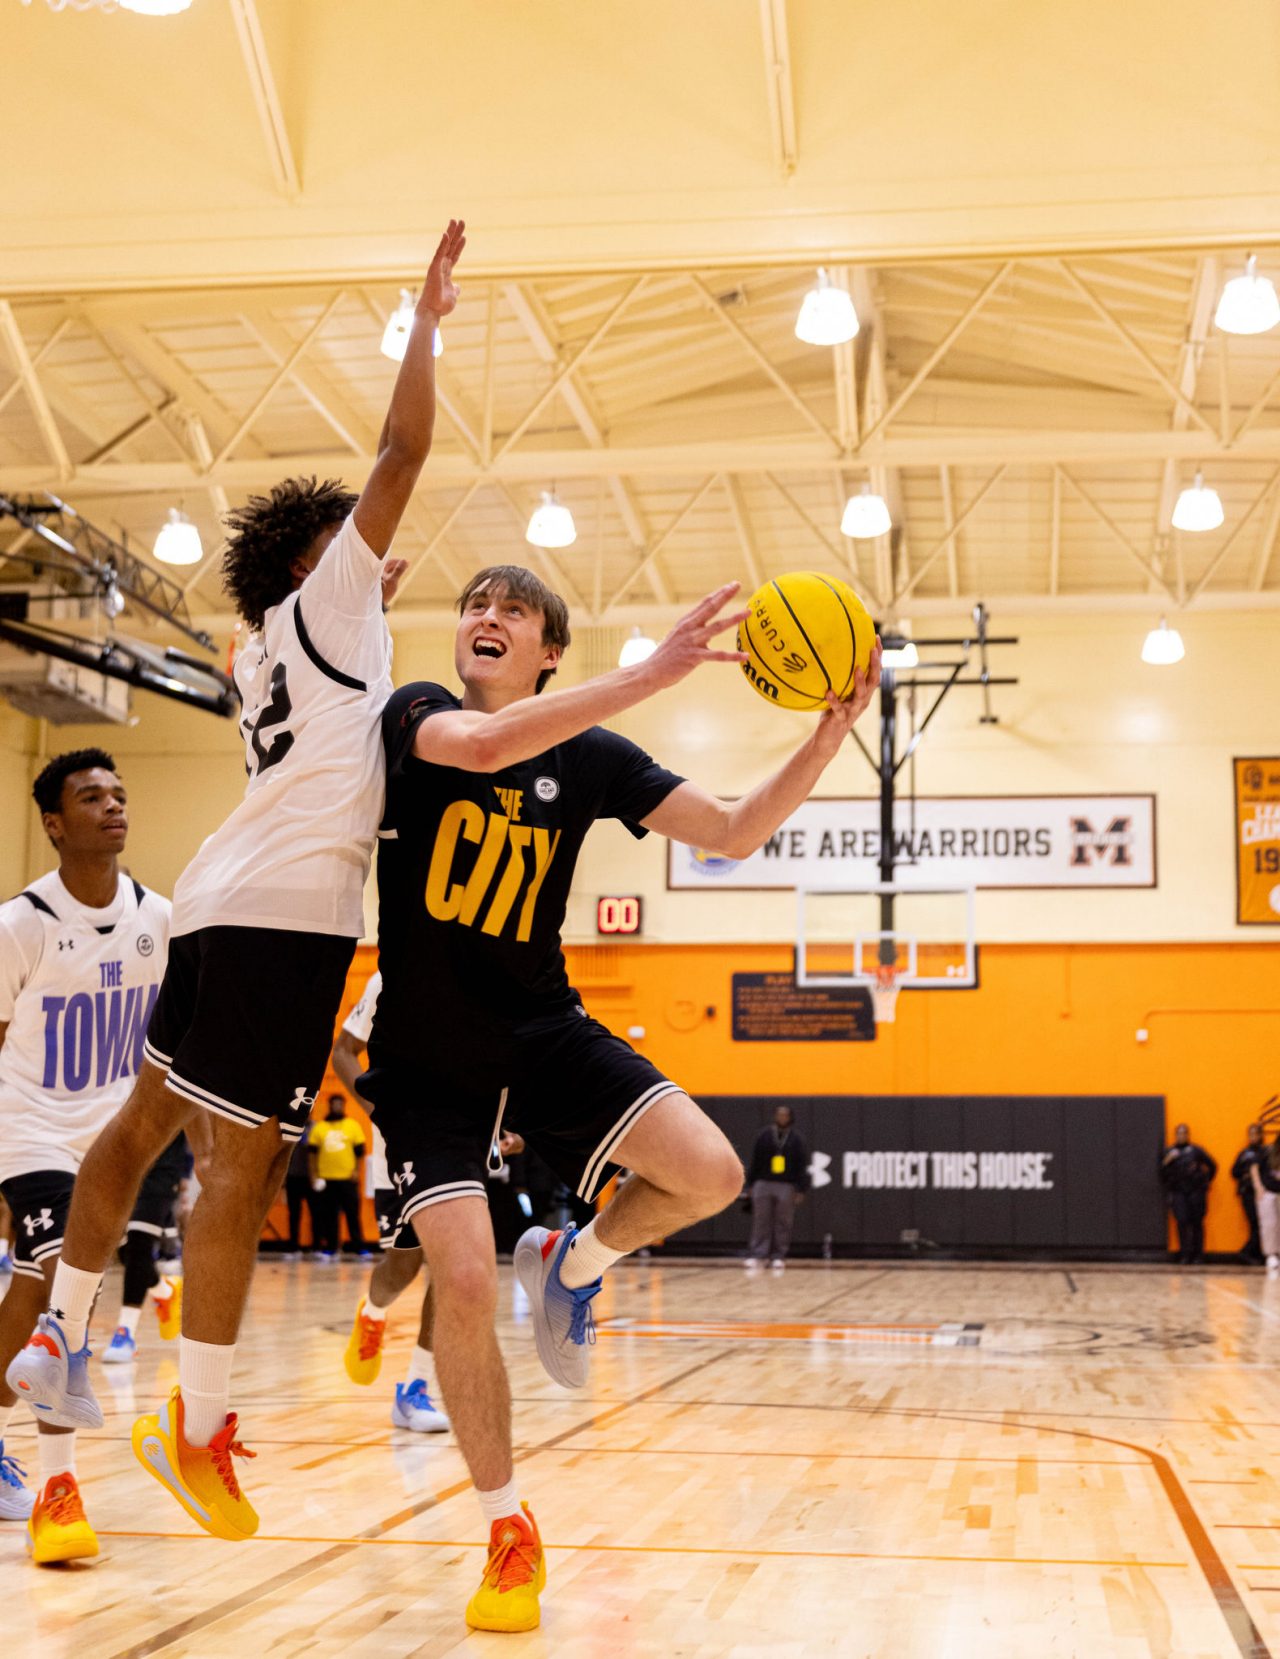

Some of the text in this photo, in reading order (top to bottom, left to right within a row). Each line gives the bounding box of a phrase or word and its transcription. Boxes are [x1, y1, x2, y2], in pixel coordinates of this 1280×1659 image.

[764, 829, 806, 857] WE
[818, 829, 878, 858] ARE
[893, 829, 1051, 857] WARRIORS
[425, 799, 562, 942] CITY
[598, 897, 639, 932] 00
[100, 960, 122, 988] THE
[843, 1151, 928, 1189] PROTECT
[931, 1151, 977, 1189] THIS
